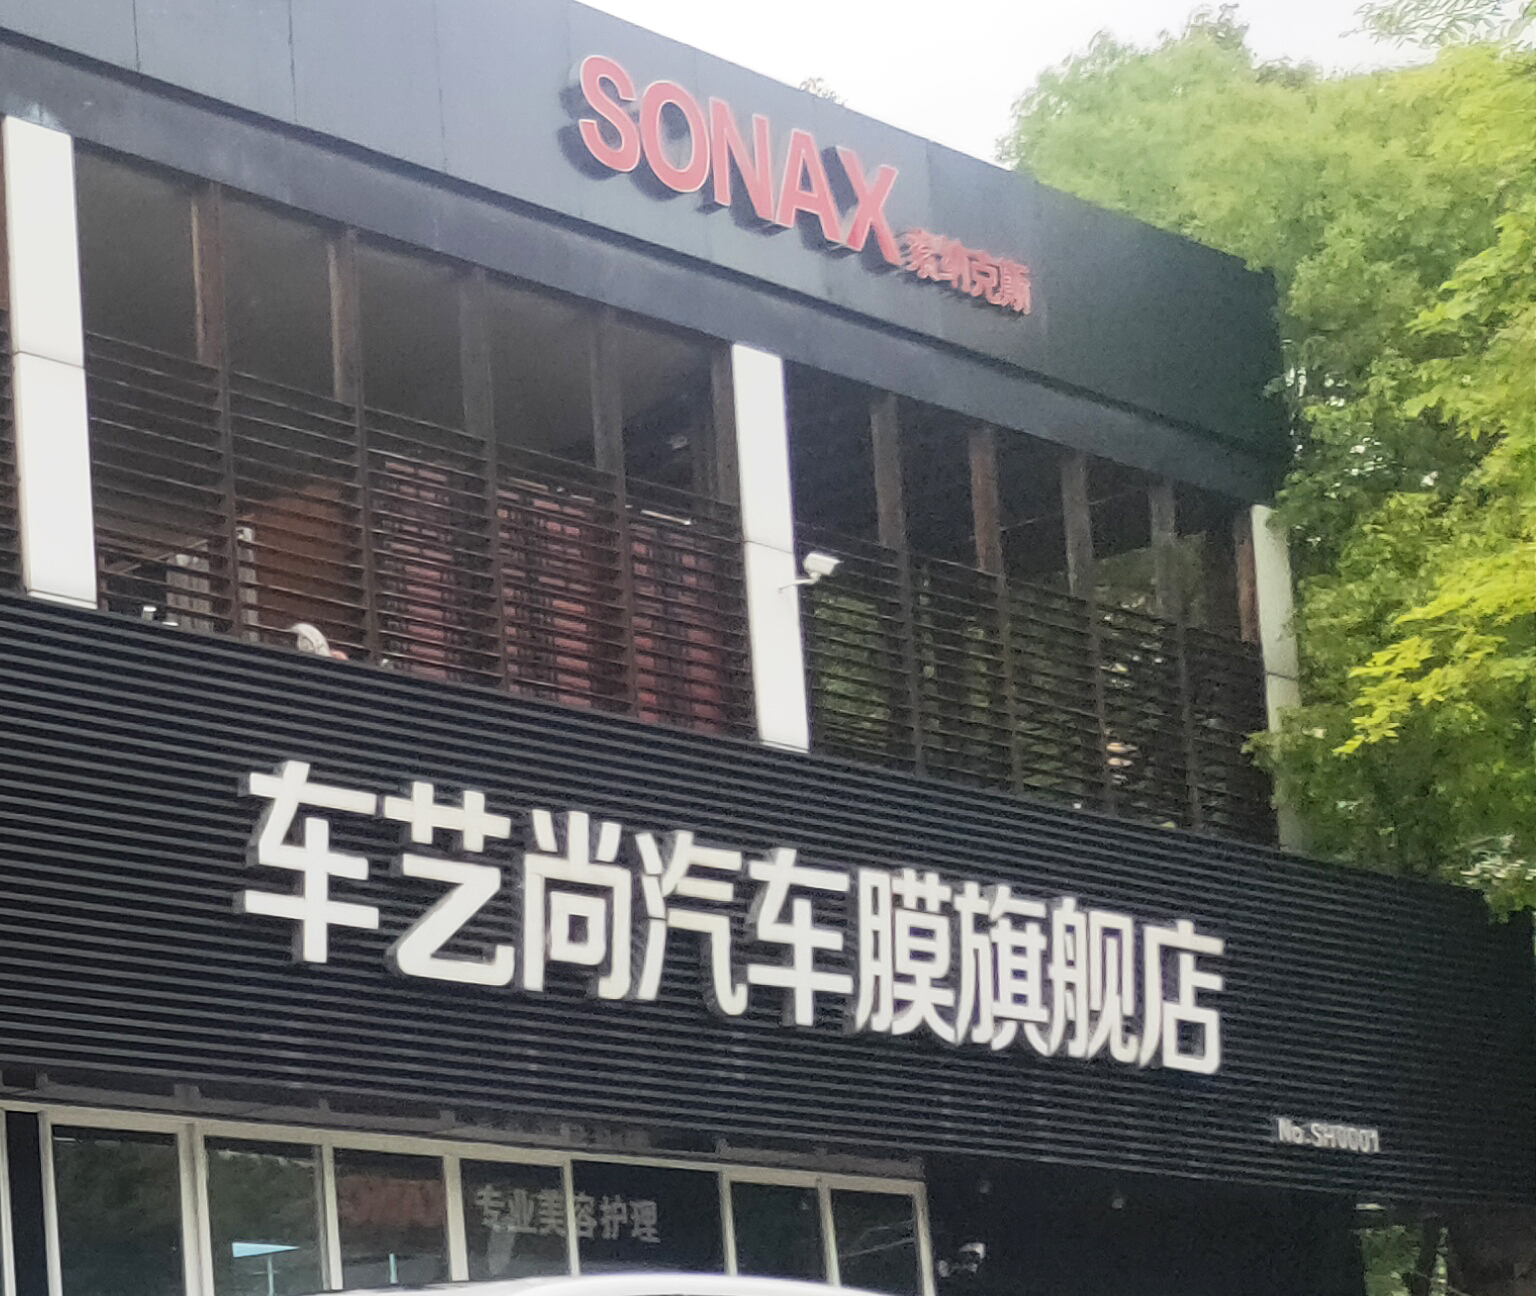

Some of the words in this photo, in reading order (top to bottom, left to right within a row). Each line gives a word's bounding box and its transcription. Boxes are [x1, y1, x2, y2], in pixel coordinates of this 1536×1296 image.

[579, 55, 902, 266] SONAX
[240, 759, 1226, 1075] 车艺尚汽车膜旗舰店
